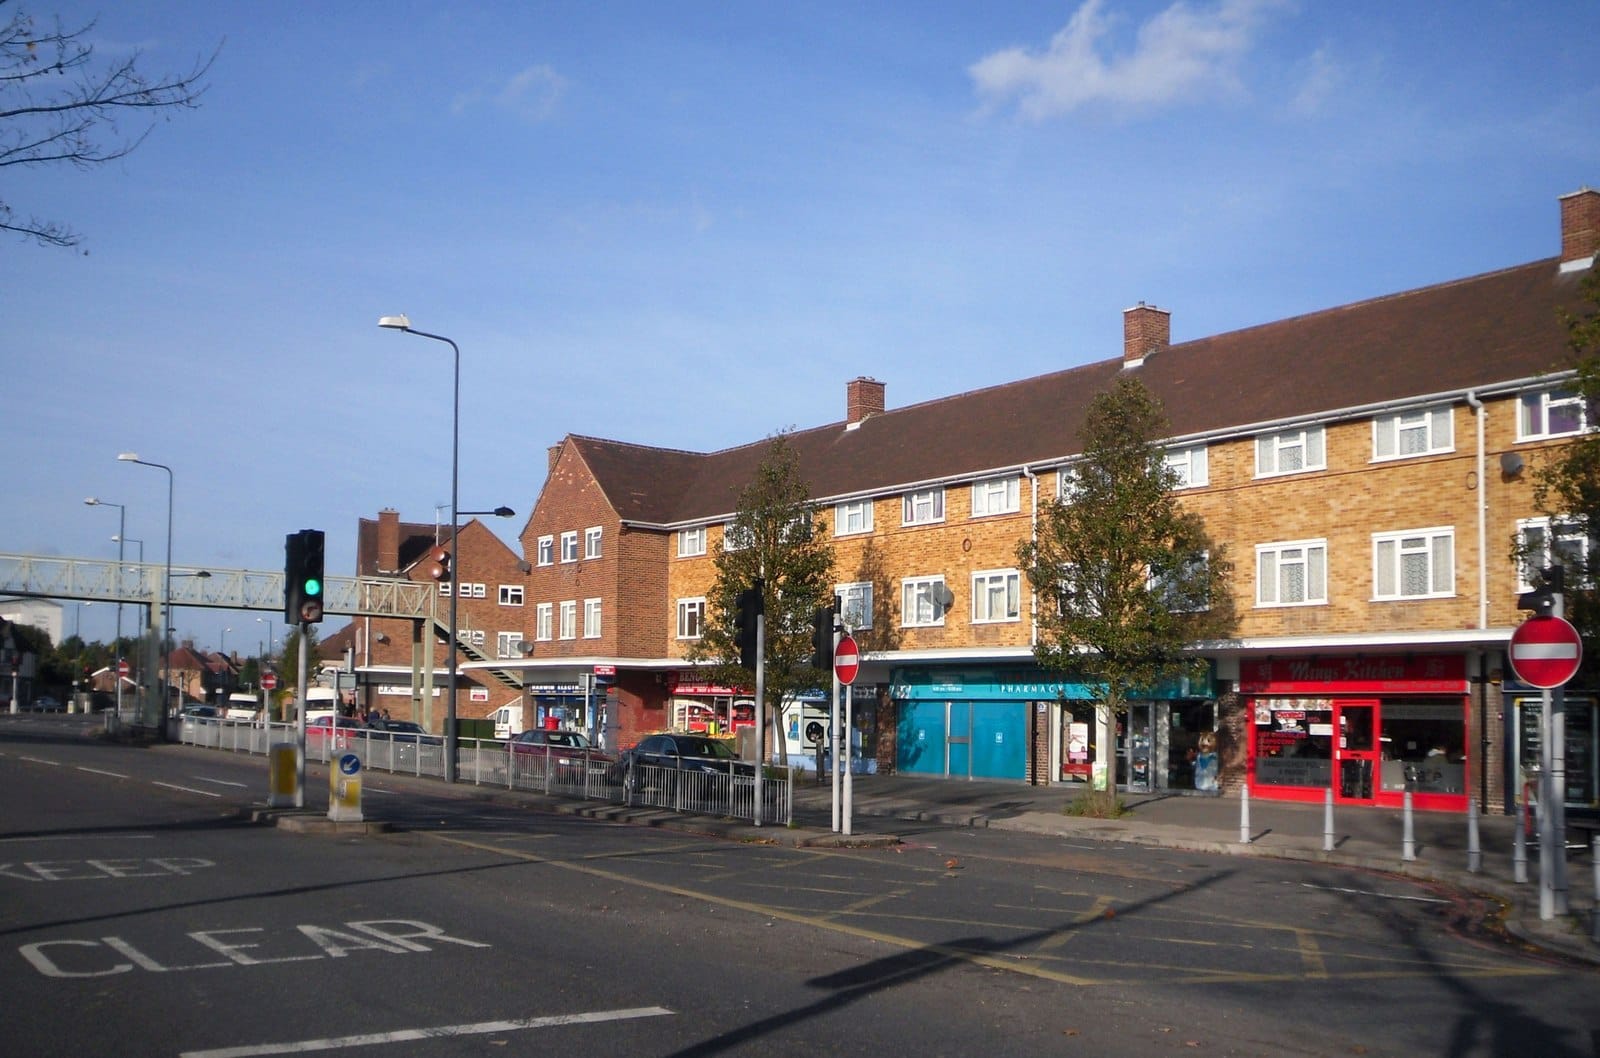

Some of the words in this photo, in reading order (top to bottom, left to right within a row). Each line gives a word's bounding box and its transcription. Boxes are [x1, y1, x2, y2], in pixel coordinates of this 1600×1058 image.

[1342, 659, 1405, 680] Kitchen
[1000, 684, 1064, 694] PHARMACY
[19, 919, 492, 978] CLEAR
